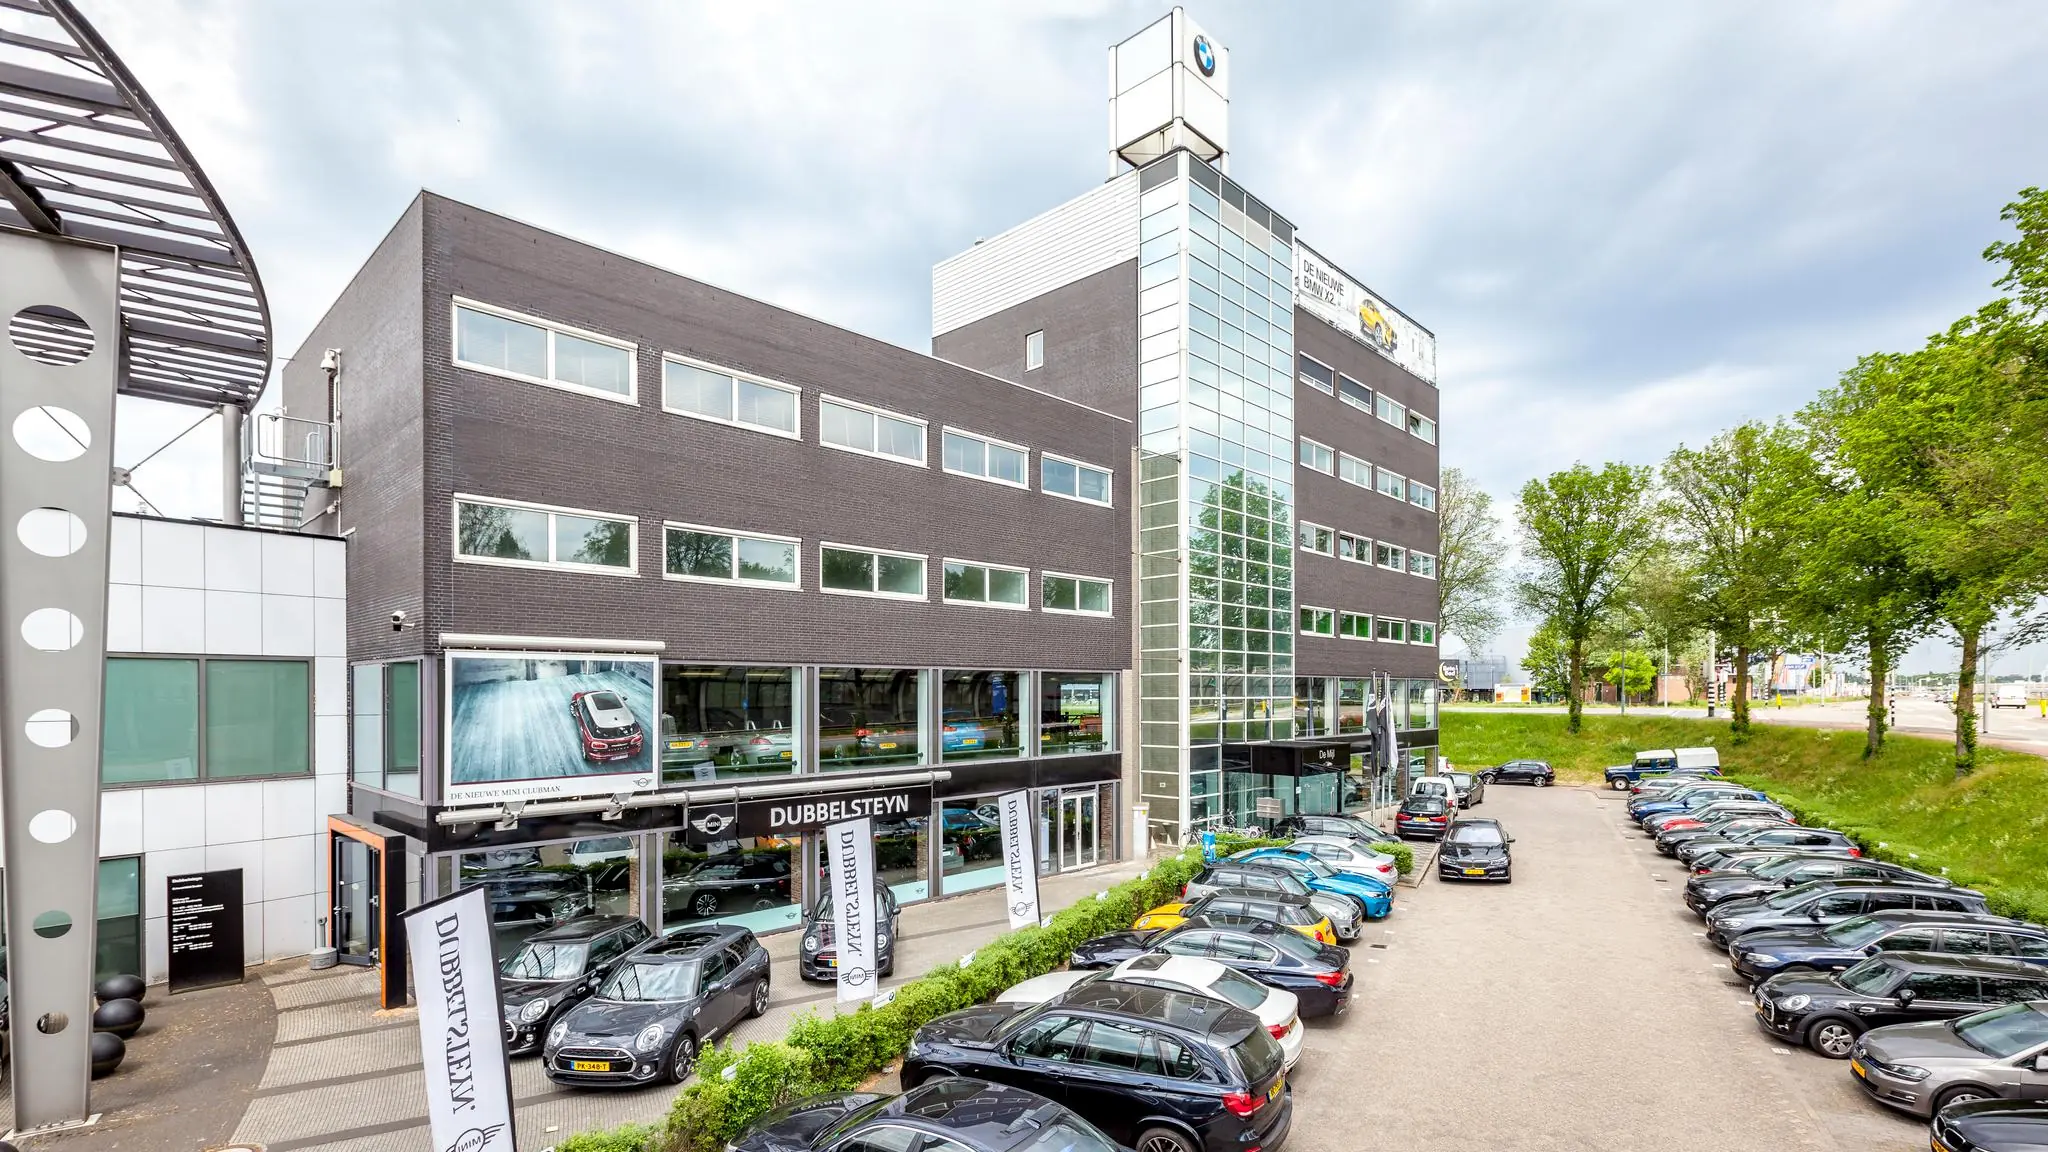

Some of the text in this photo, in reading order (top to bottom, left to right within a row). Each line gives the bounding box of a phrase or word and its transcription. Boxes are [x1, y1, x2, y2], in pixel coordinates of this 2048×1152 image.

[1303, 259, 1345, 297] DE NIEUWE
[1303, 276, 1323, 299] BMW
[1319, 749, 1327, 759] De
[450, 792, 463, 800] DE
[464, 789, 500, 799] NIEUWE
[501, 788, 521, 797] MINI
[770, 794, 909, 828] DUBBELSTEYN
